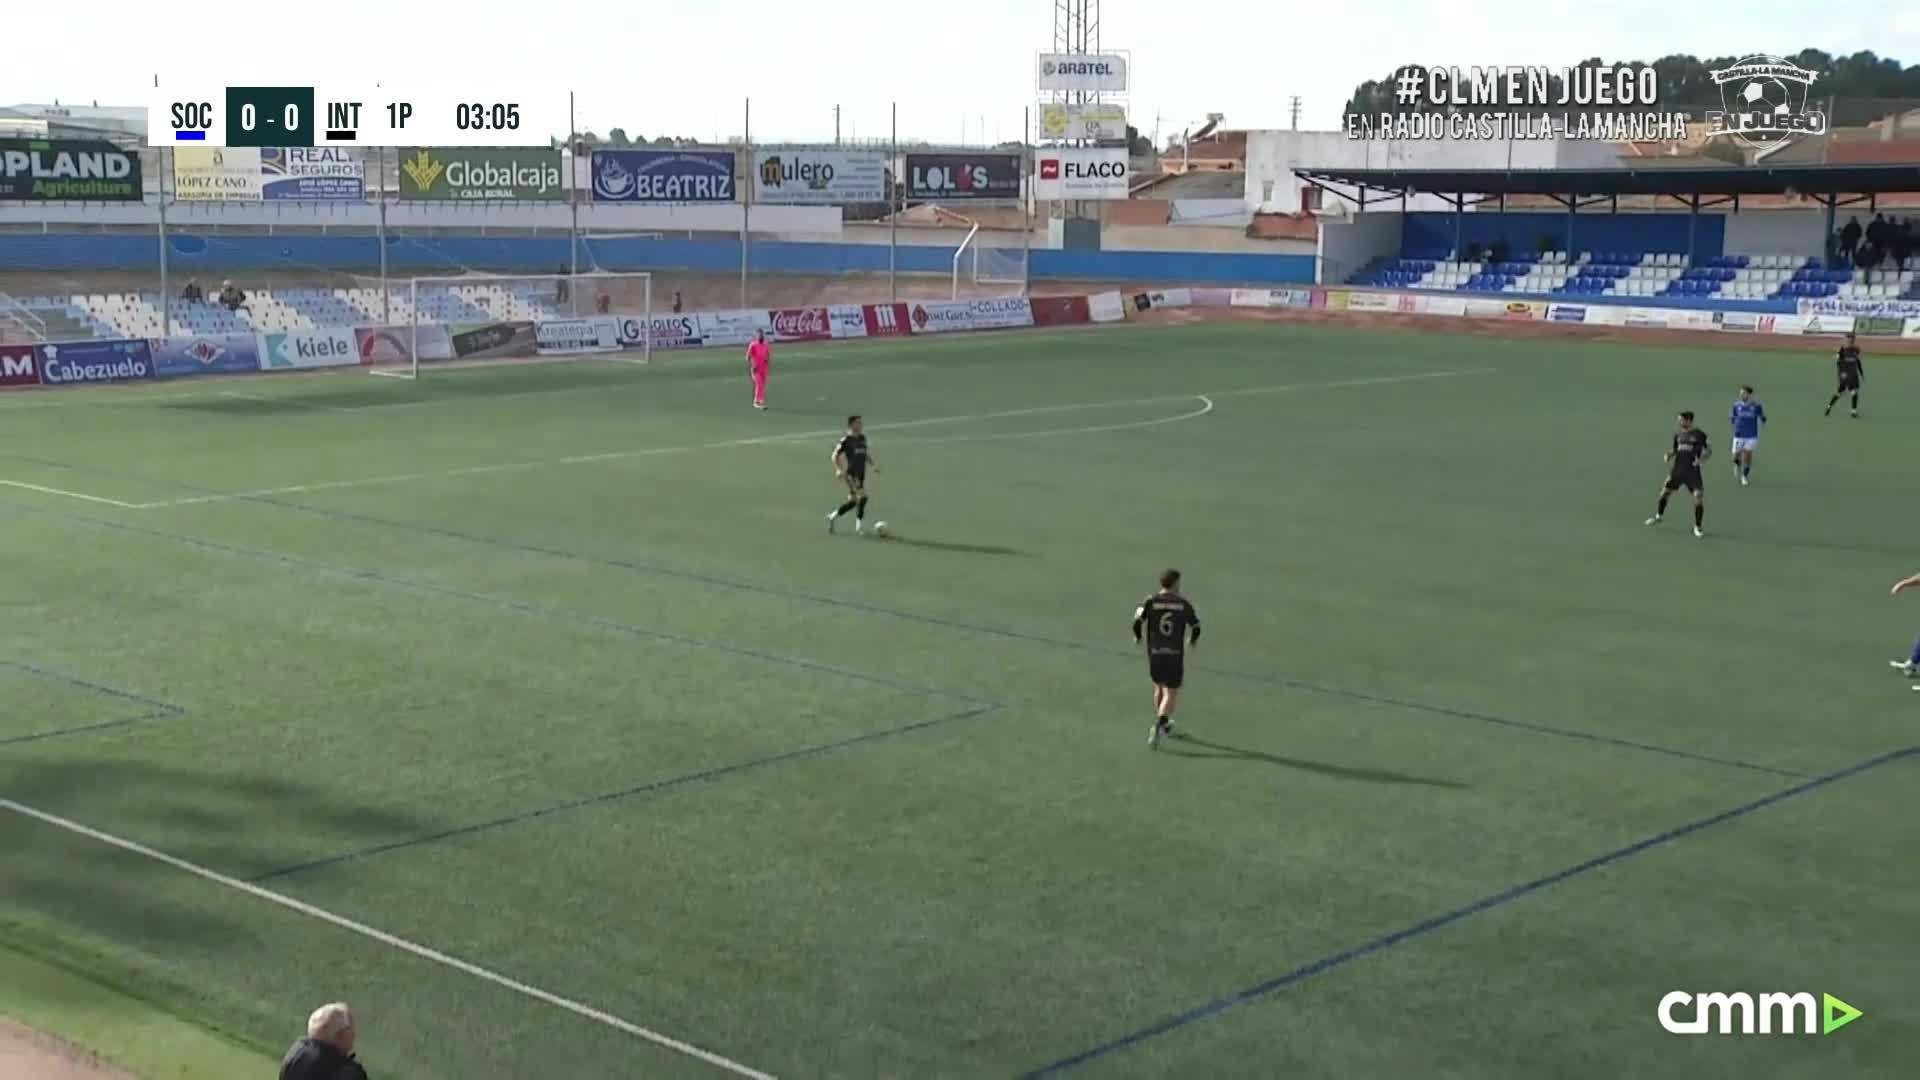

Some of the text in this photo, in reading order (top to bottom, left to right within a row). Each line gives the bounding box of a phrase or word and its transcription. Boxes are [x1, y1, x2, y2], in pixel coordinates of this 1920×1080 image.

[290, 147, 353, 162] REAL
[290, 165, 362, 176] SEGUROS
[446, 160, 559, 194] Globalcaja
[1065, 162, 1126, 179] FLACO
[32, 180, 131, 198] Agriculture
[215, 175, 247, 188] CANO
[638, 174, 731, 203] BEATRIZ
[296, 338, 349, 359] kiele
[44, 357, 146, 383] Cabezuelo
[1159, 612, 1174, 636] 6
